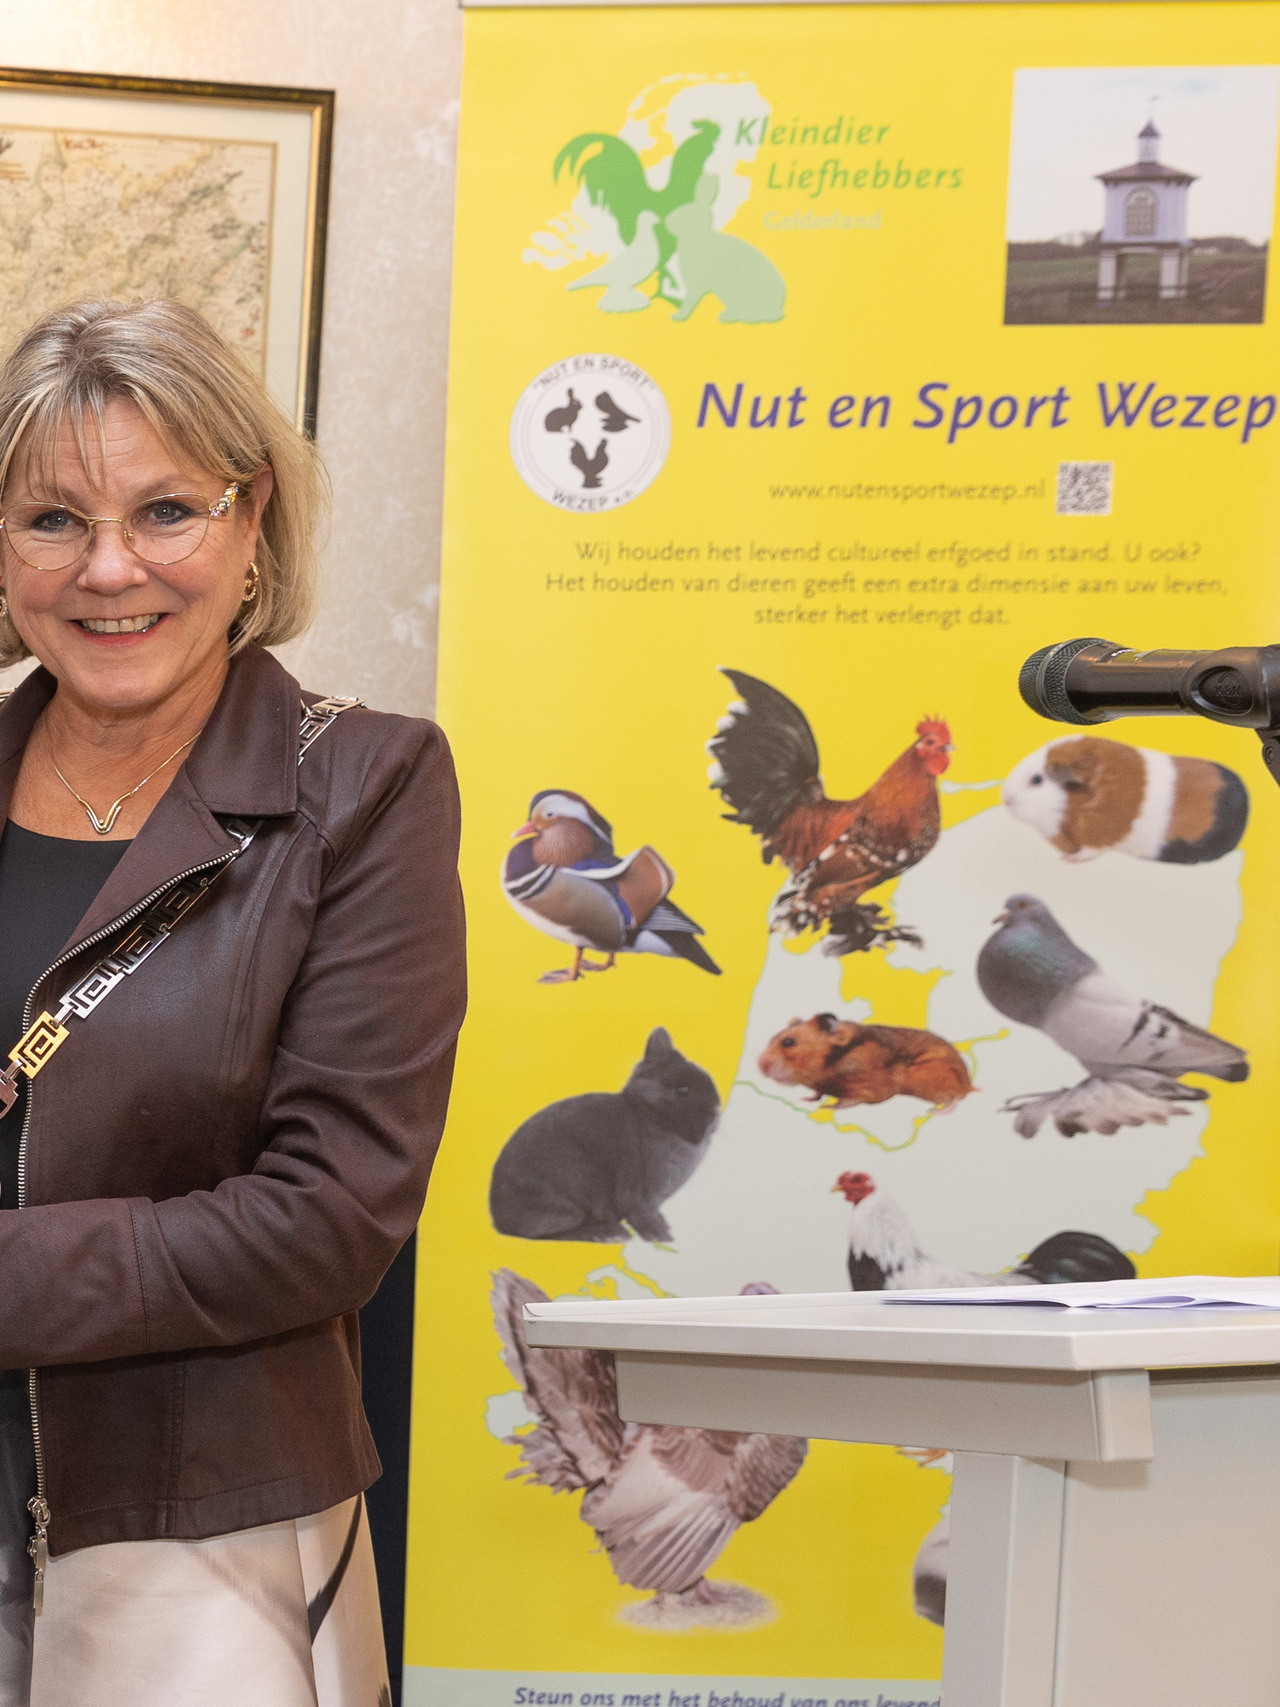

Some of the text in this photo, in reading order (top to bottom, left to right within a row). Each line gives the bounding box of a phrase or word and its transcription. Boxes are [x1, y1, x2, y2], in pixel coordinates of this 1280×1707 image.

[734, 115, 891, 146] Kleindier
[766, 158, 964, 199] Liefhebbers
[763, 209, 883, 231] Gelderland
[696, 381, 1277, 445] Nut en Sport Wezep
[552, 487, 609, 511] WEZEP
[770, 478, 1046, 504] www.nutensportwezep.nl
[575, 540, 1202, 568] Wij houden het levend cultureel erfgoed in stand. U ook?
[546, 571, 1229, 599] Het houden van dieren geeft een extra dimensie aan uw leven,
[753, 604, 1011, 631] sterker het verlengt dat.
[514, 1686, 574, 1706] Steun
[579, 1692, 615, 1707] ons
[621, 1691, 662, 1707] met
[668, 1688, 701, 1707] het
[707, 1690, 786, 1707] behoud
